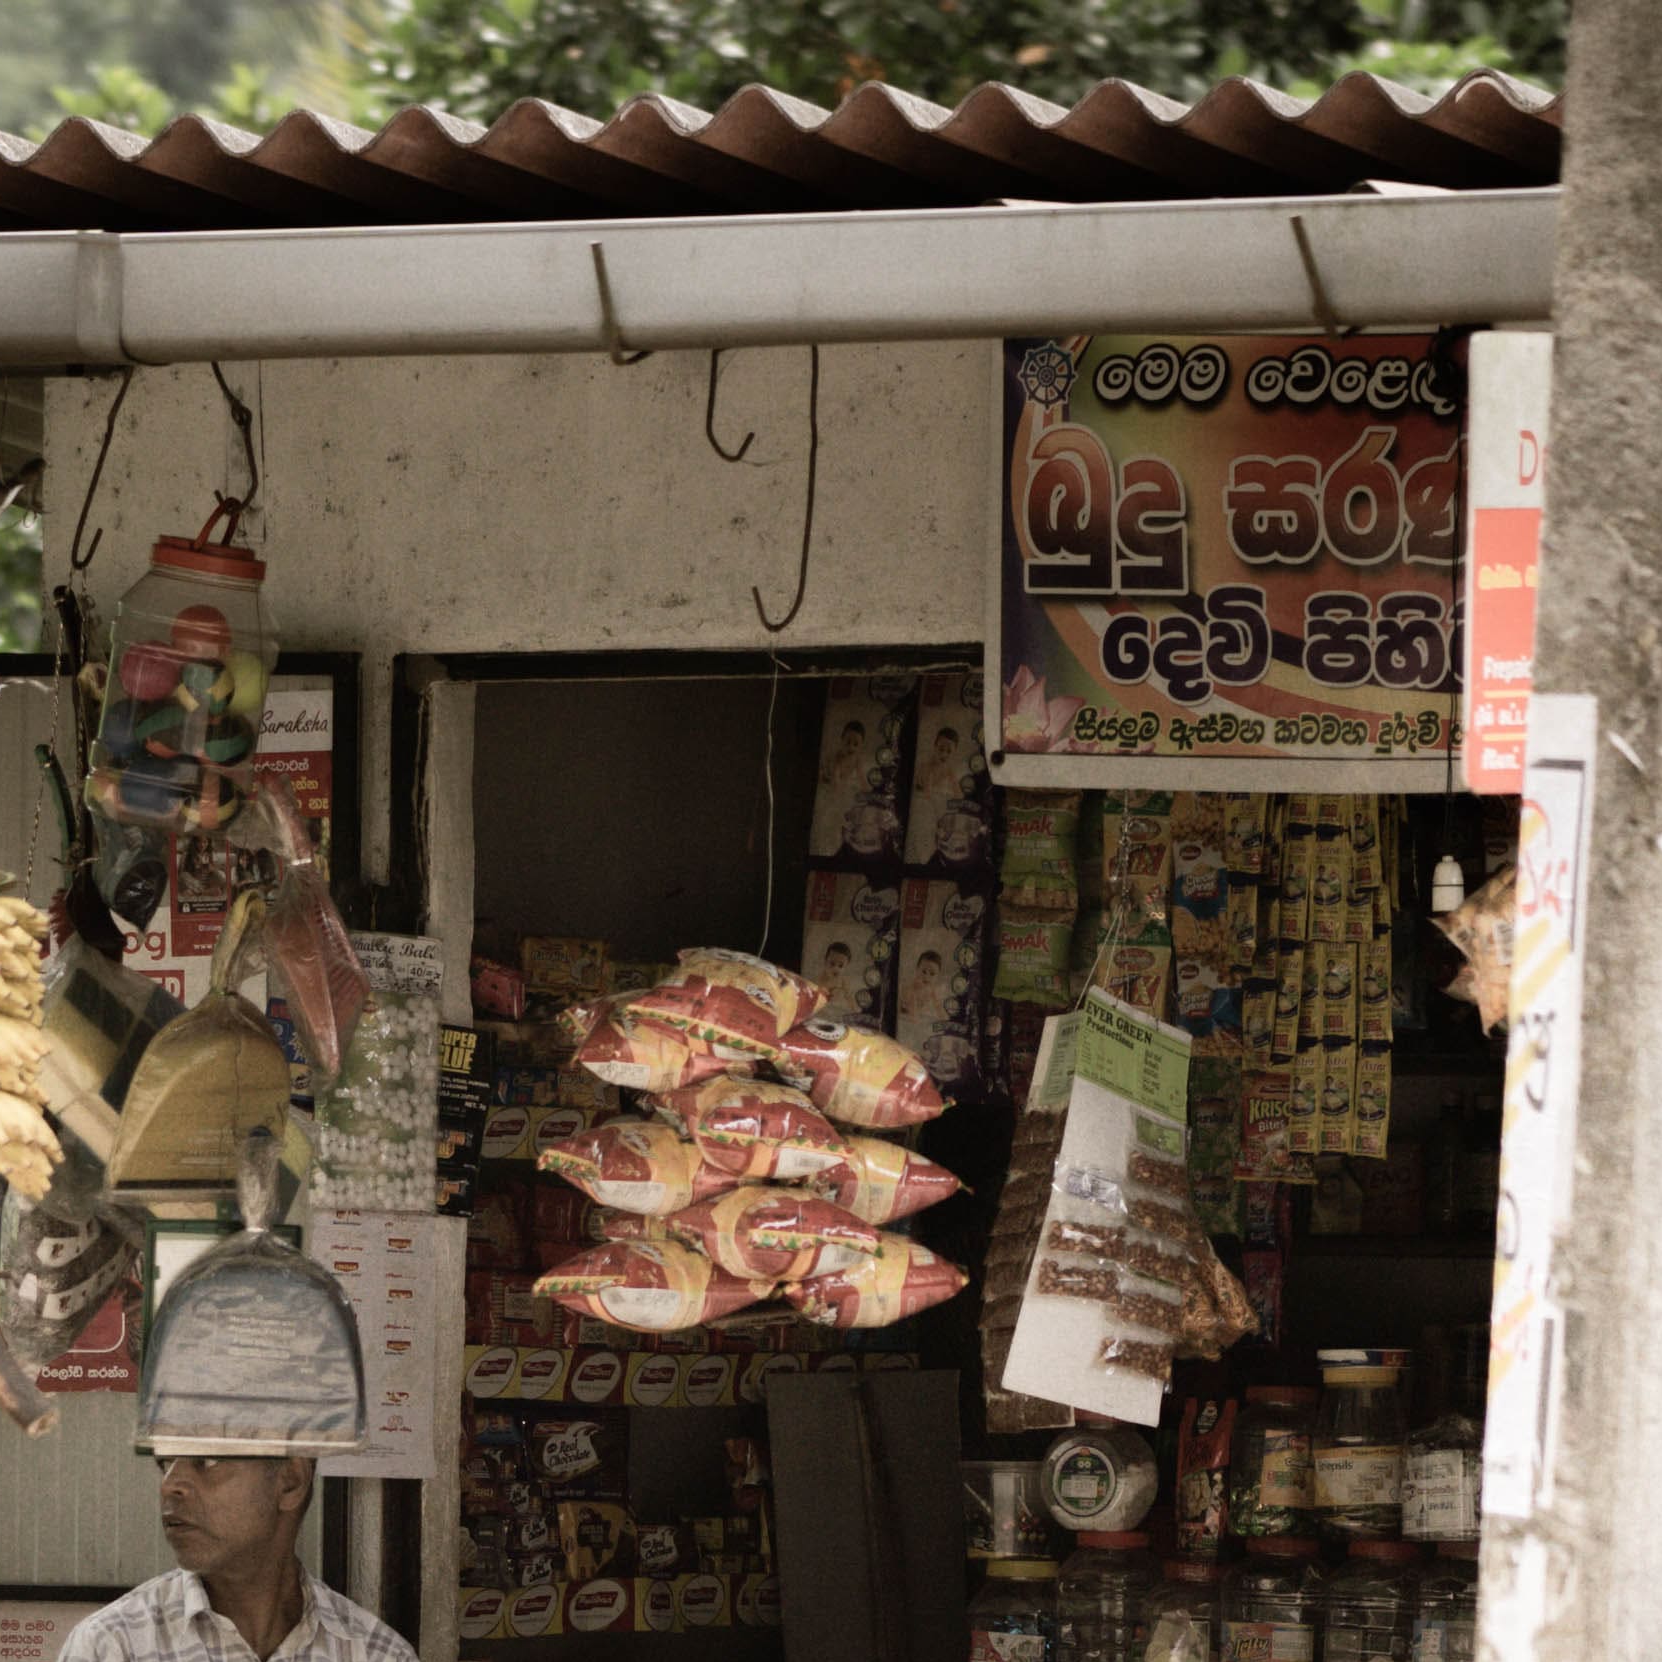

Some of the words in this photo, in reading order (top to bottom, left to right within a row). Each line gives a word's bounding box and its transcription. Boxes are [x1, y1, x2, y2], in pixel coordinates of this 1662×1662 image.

[1024, 423, 1189, 596] බුදු
[1086, 1002, 1114, 1028] EVER
[1116, 1017, 1153, 1045] GREEN
[1249, 1100, 1291, 1125] KRISC
